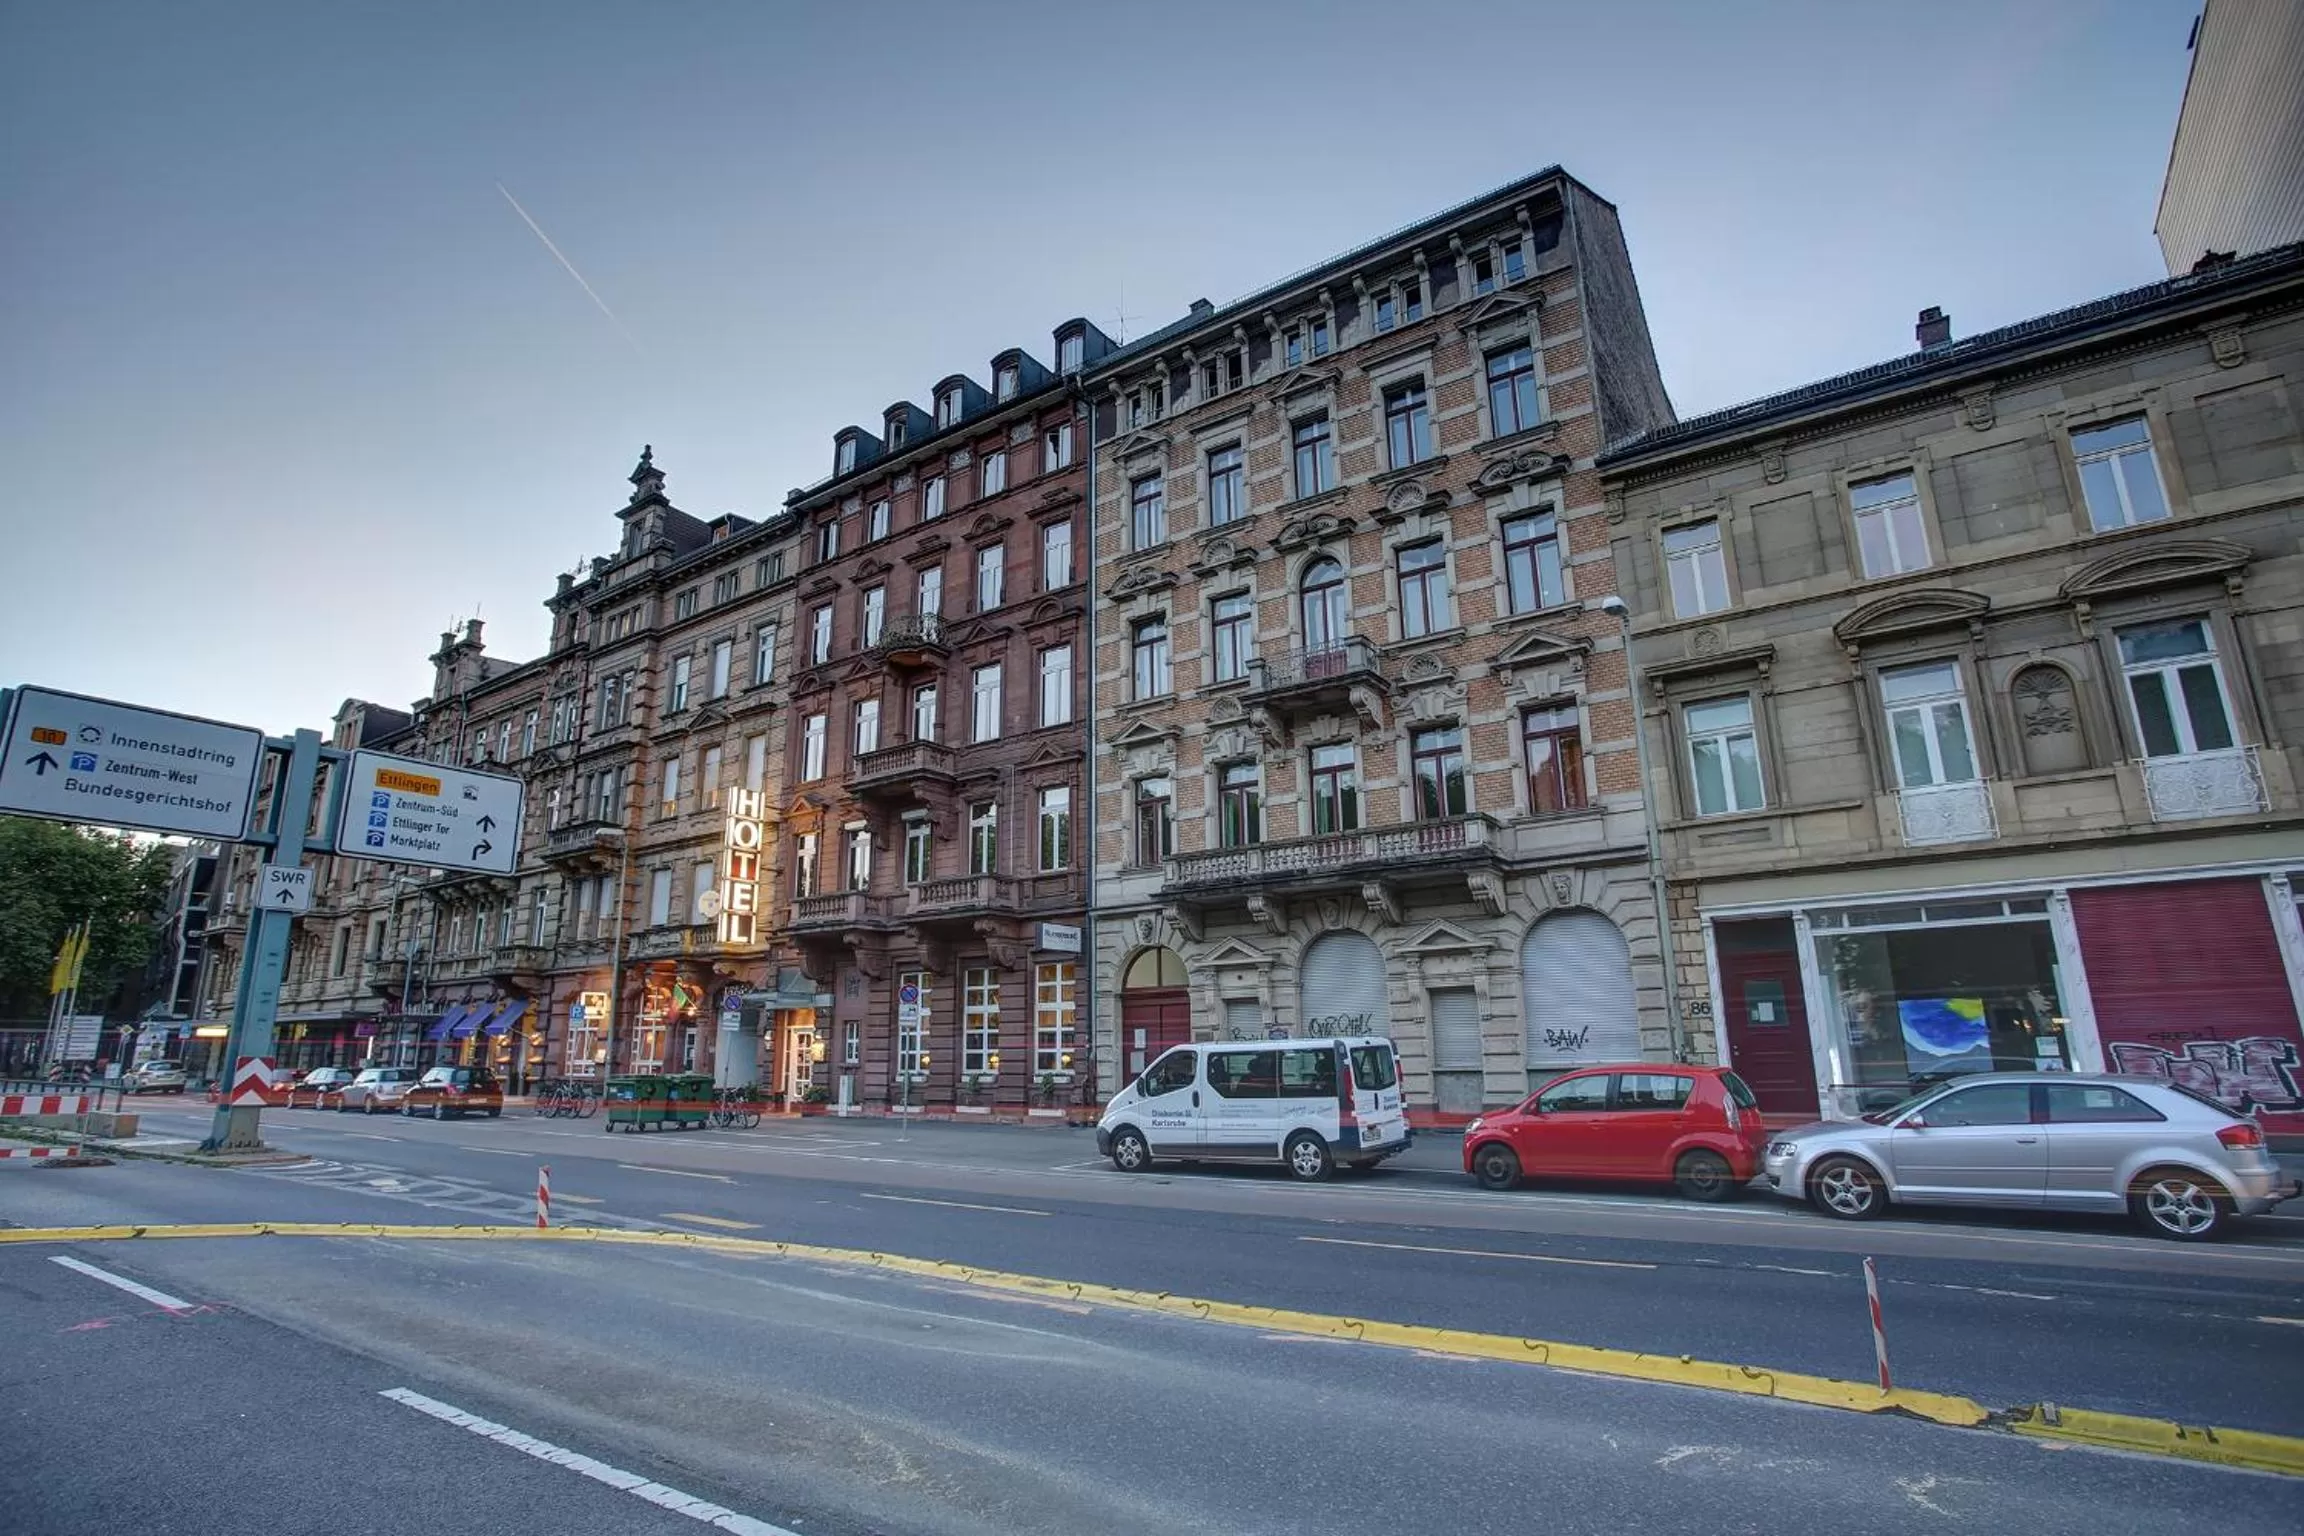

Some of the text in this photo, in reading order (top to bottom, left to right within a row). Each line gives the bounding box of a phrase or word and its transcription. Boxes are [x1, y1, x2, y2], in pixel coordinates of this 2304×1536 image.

[111, 732, 236, 767] Innenstadtring
[105, 759, 198, 785] Zentrum-West
[380, 773, 437, 792] Ettlingen
[64, 778, 232, 813] Bundesgerichtshof
[395, 797, 459, 817] Zentrum-Süd
[392, 816, 433, 833] Ettlinger
[436, 823, 450, 834] Tor
[390, 834, 441, 851] Marktplatz
[730, 788, 760, 943] HOTEL
[271, 870, 305, 885] SWR
[1691, 1002, 1711, 1015] 86
